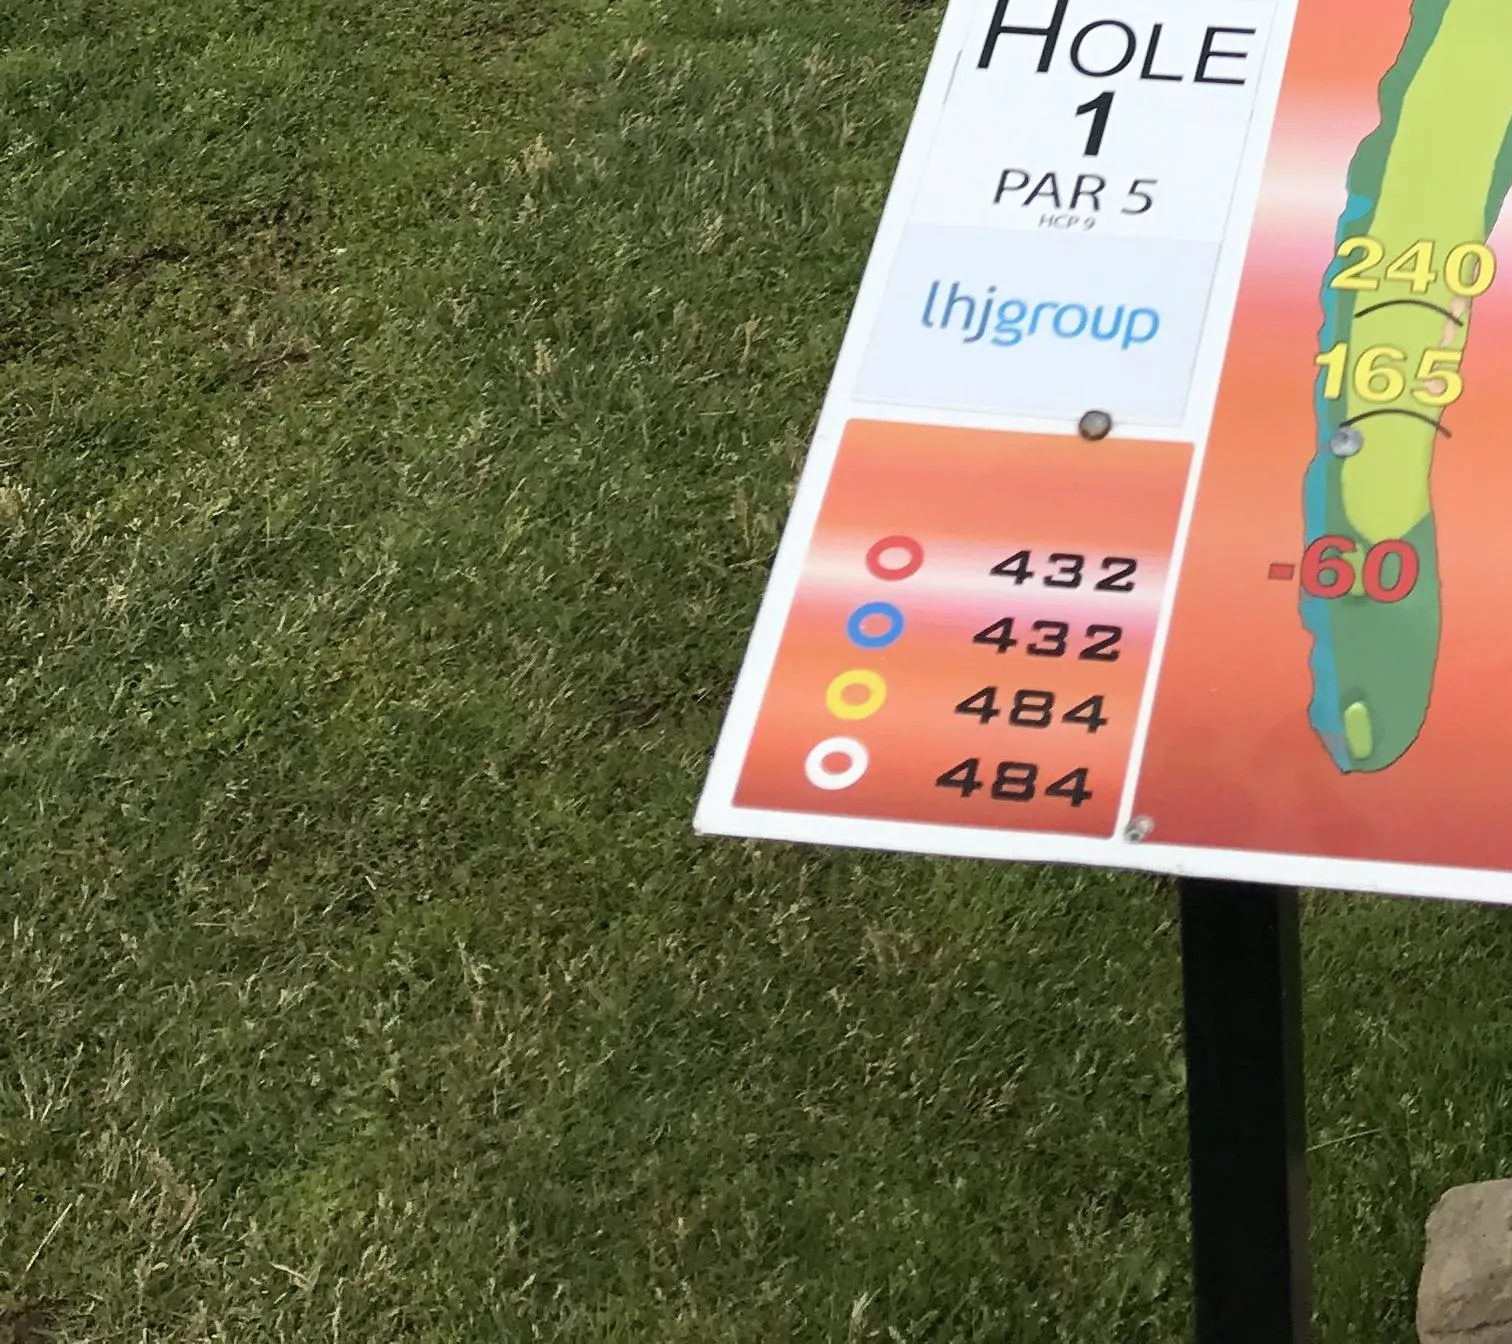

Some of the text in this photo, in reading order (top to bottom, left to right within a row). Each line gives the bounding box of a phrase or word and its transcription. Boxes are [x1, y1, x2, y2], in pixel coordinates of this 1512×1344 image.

[1074, 90, 1116, 157] 1
[992, 168, 1158, 215] PAR 5
[1039, 213, 1080, 230] HCP
[1330, 236, 1497, 297] 240
[921, 279, 1160, 350] lhjgroup
[1315, 342, 1465, 406] 165
[990, 550, 1138, 593] 432
[1268, 534, 1420, 603] -60
[972, 617, 1123, 662] 432
[954, 686, 1110, 734] 484
[935, 757, 1094, 808] 484
